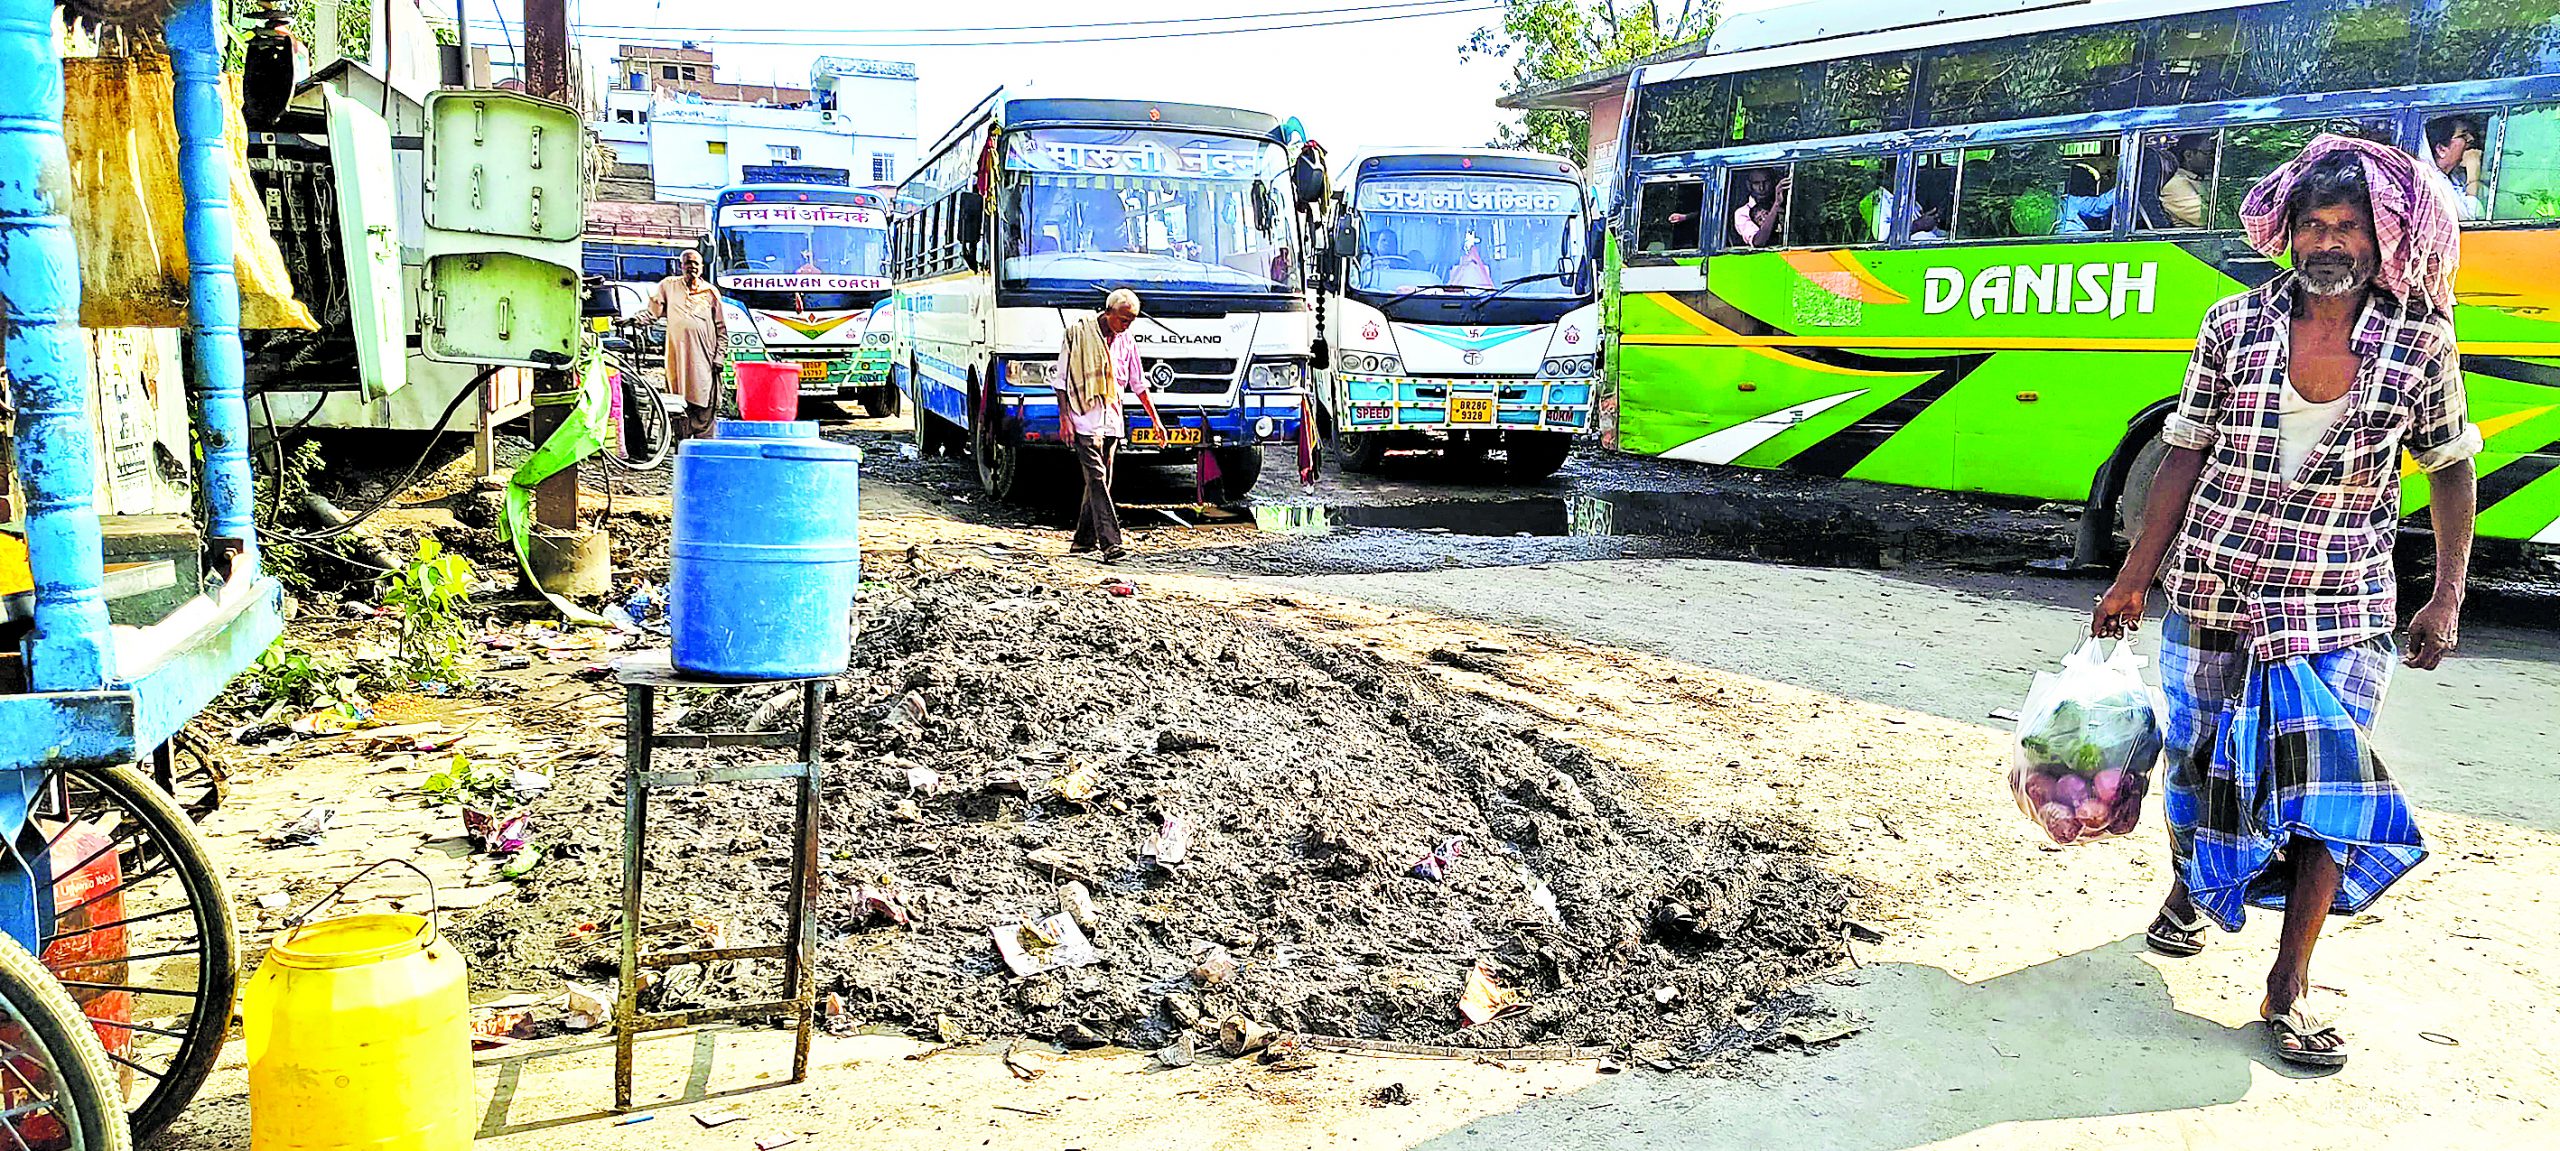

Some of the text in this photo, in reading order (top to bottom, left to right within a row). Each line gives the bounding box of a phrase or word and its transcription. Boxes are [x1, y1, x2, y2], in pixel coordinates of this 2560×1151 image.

[1376, 187, 1426, 209] जय
[1467, 183, 1562, 210] अम्बिके
[733, 208, 768, 220] जय
[733, 277, 880, 289] PAHALWAN COACH
[1923, 261, 2158, 320] DANISH
[1161, 335, 1222, 344] LEYLAND
[1356, 406, 1391, 419] SPEED
